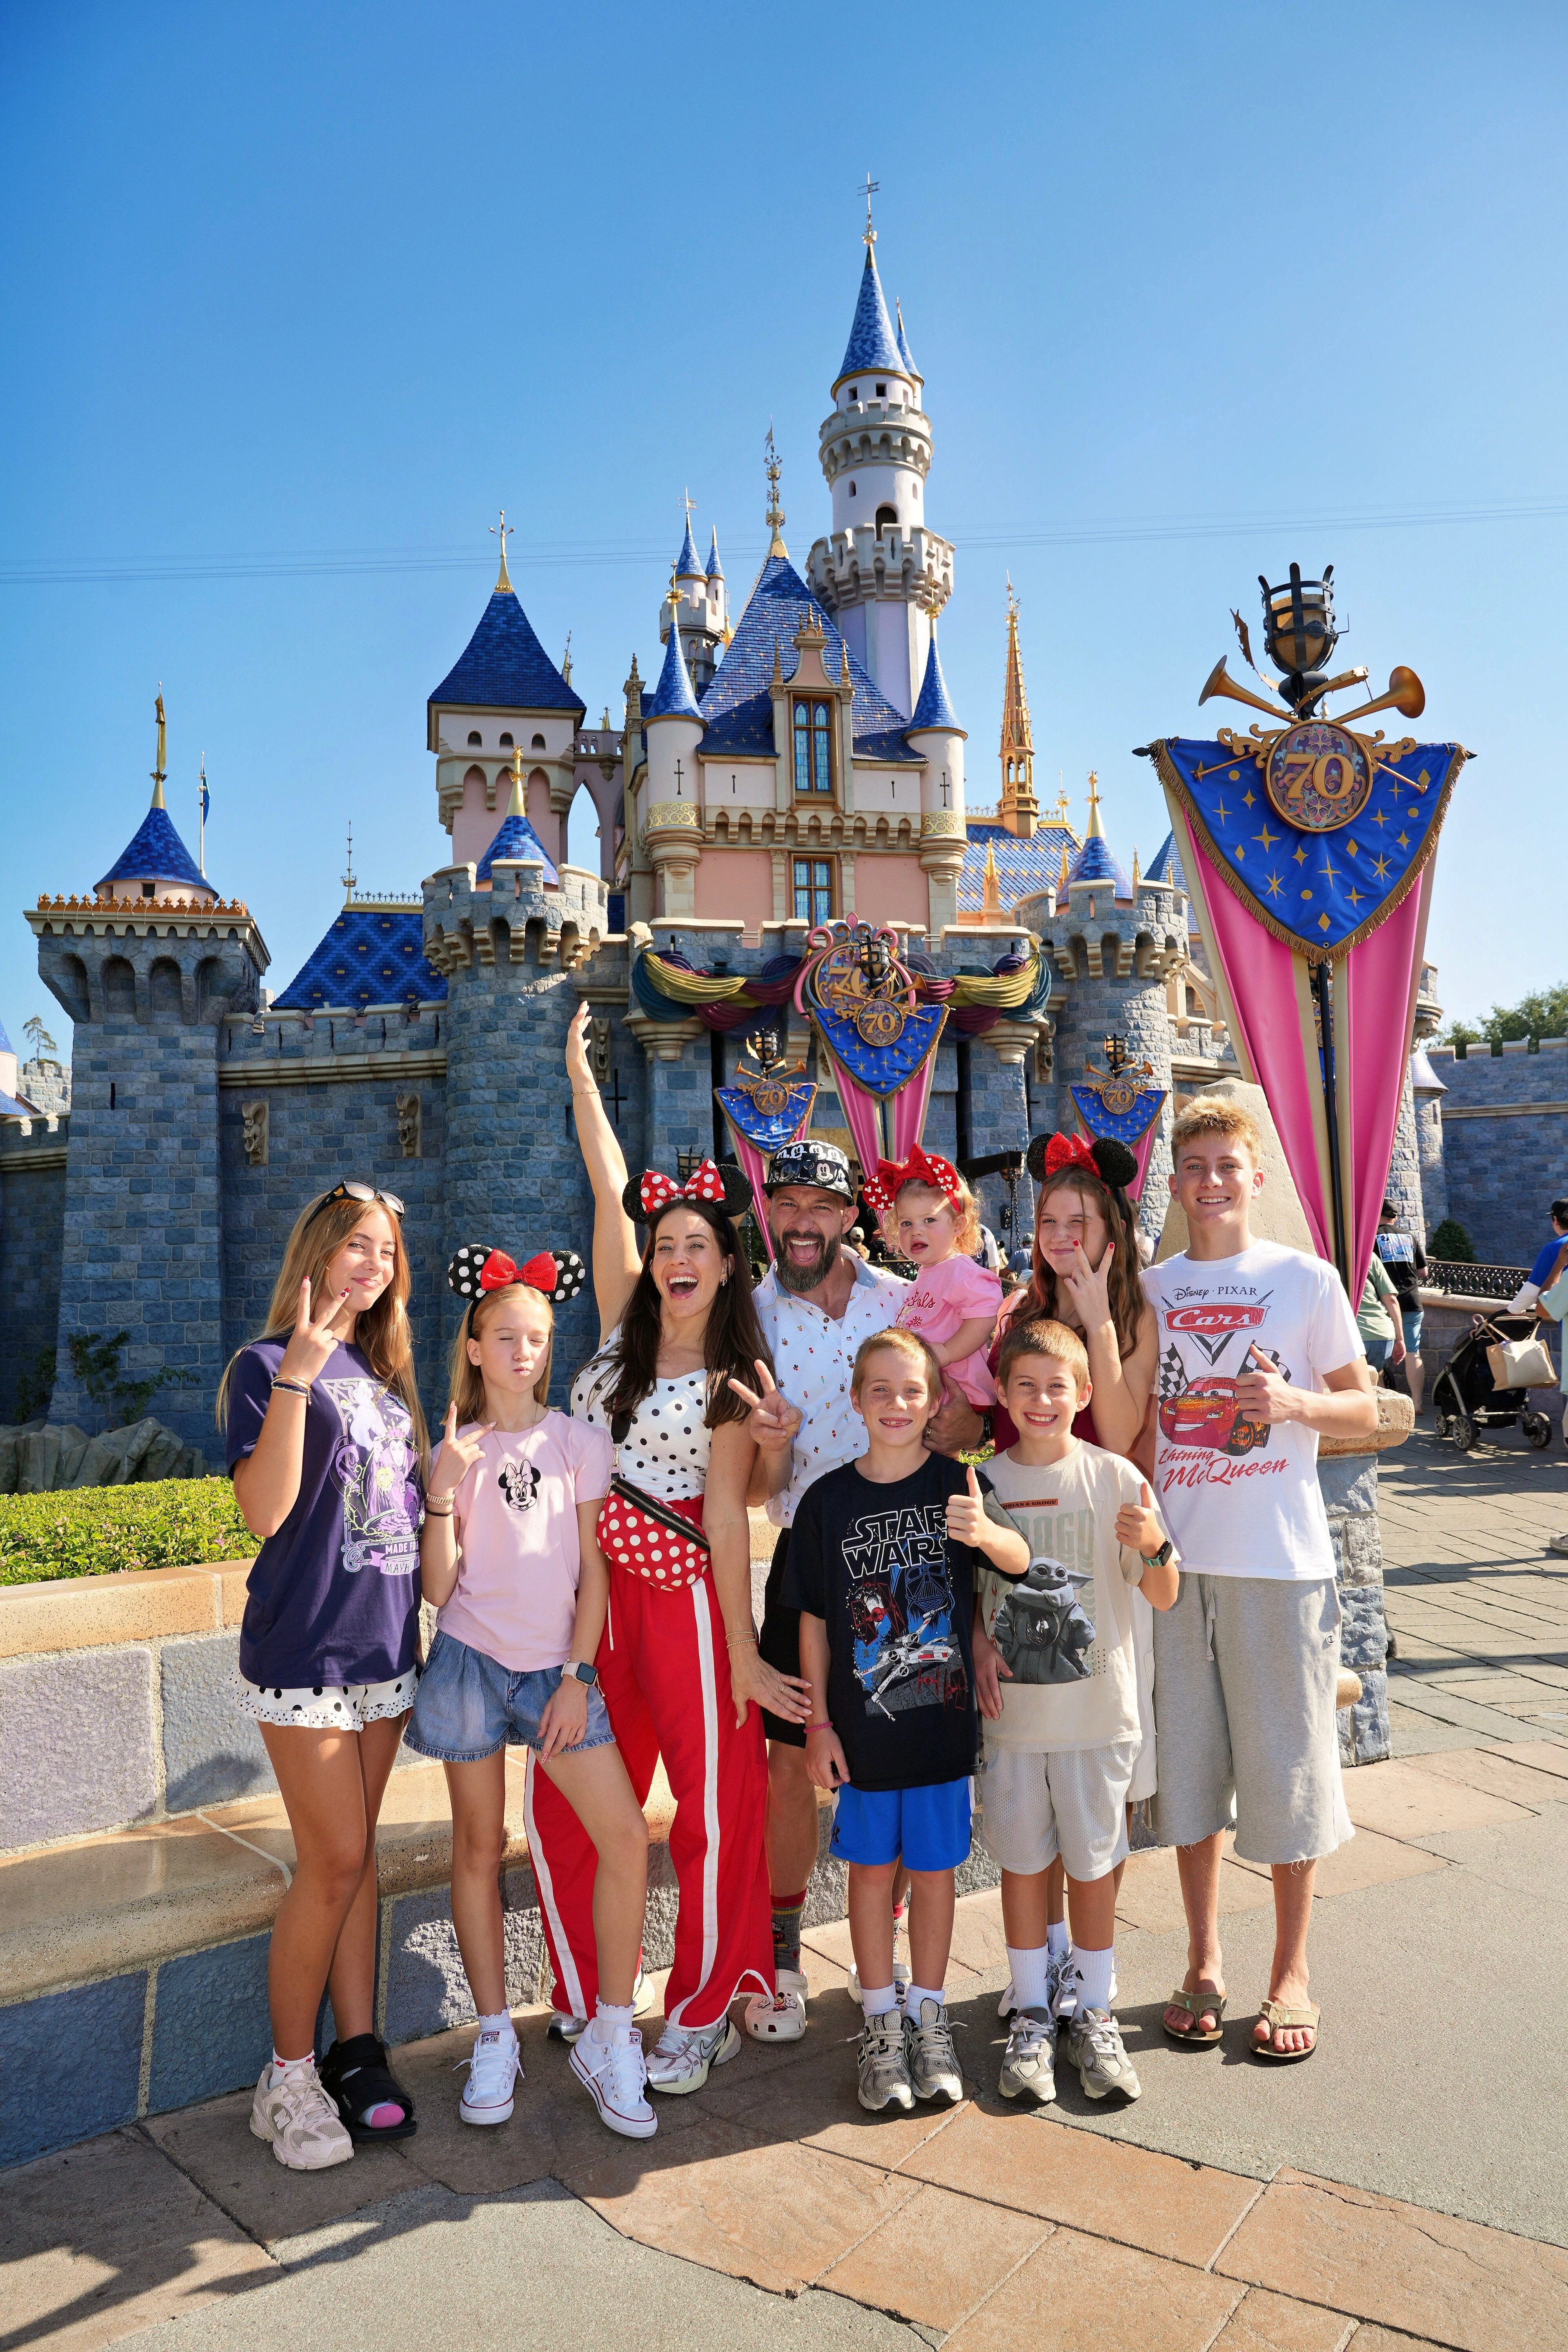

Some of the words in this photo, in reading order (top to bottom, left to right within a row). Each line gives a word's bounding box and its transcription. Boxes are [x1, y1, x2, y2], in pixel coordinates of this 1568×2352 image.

[1284, 753, 1354, 800] 70
[864, 1013, 896, 1033] 70
[759, 1090, 783, 1106] 70
[1107, 1090, 1130, 1105] 70
[1217, 1286, 1258, 1296] PIXAR
[1172, 1309, 1255, 1327] Cars
[1163, 1457, 1290, 1493] McQueen
[842, 1504, 947, 1551] STAR
[385, 1542, 408, 1555] MADE
